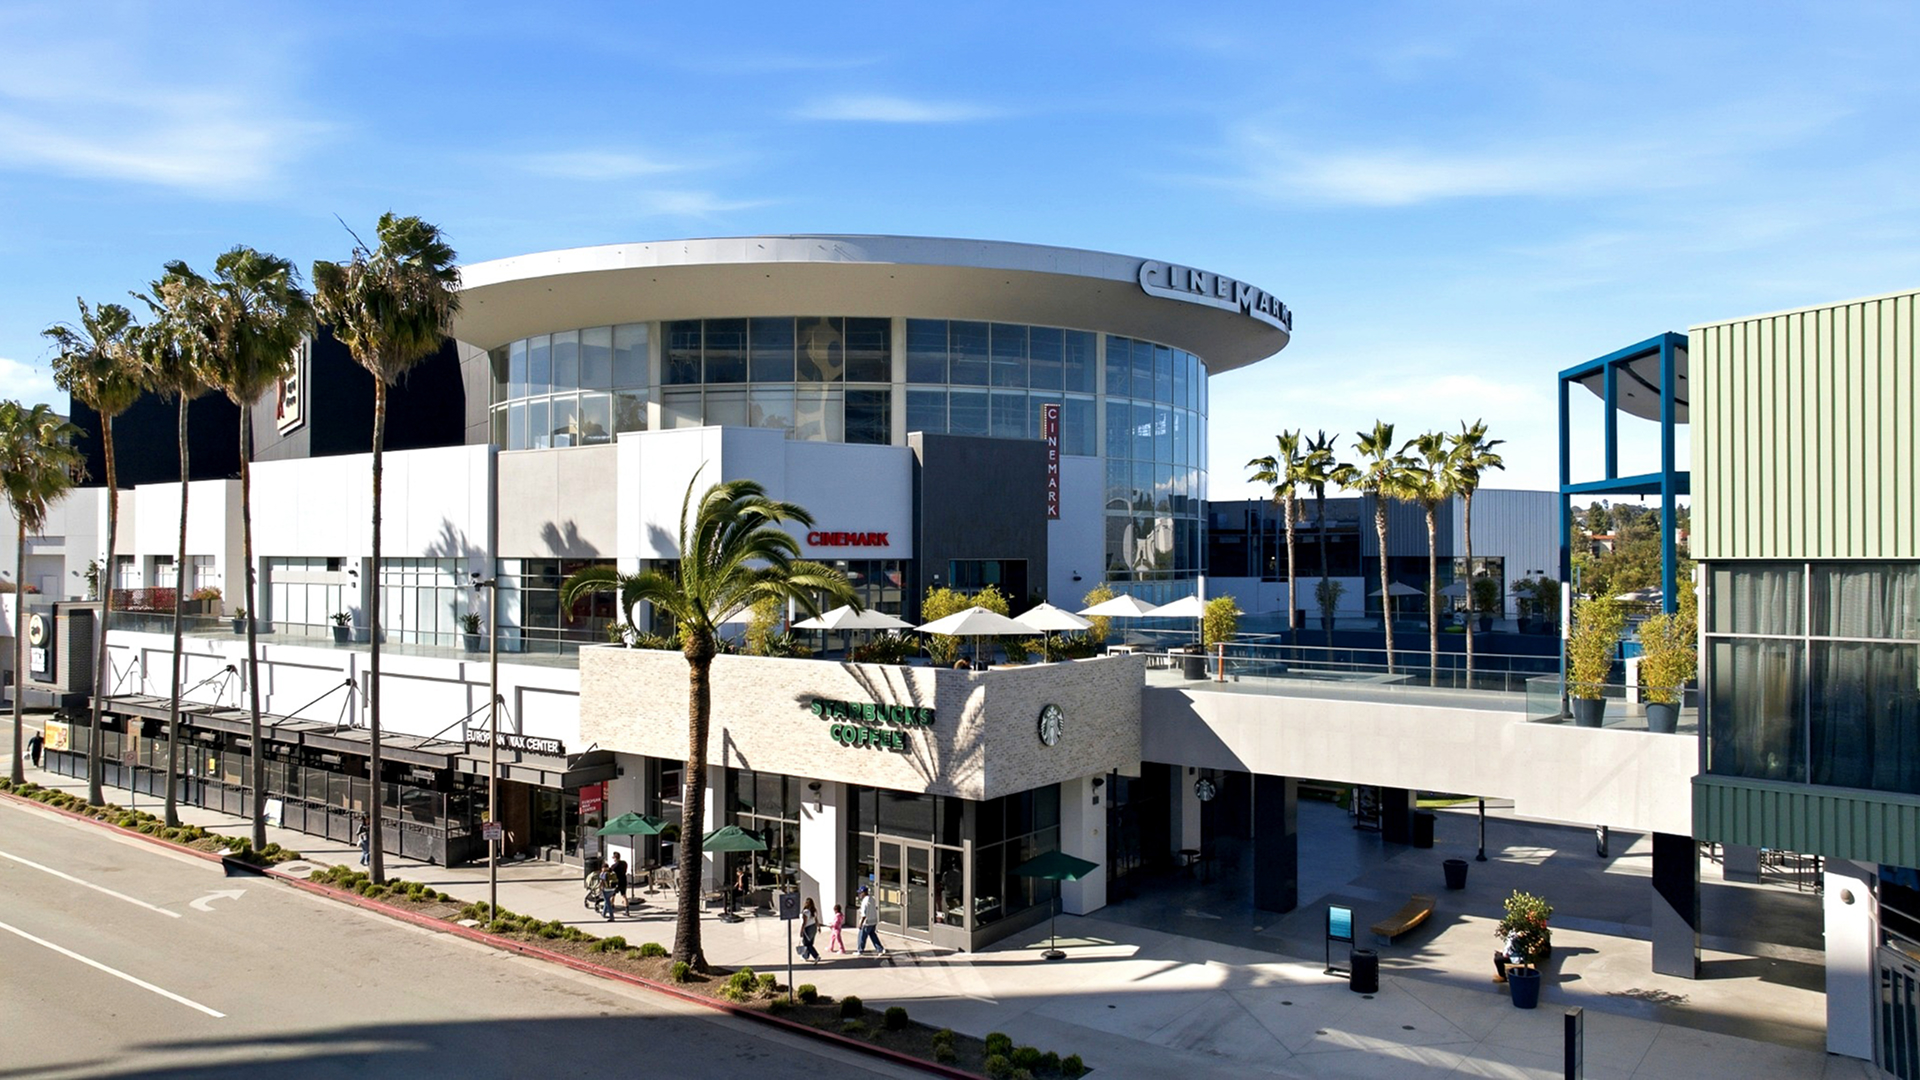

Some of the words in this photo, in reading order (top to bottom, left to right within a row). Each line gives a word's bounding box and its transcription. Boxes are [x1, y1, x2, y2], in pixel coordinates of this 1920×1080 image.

[1139, 260, 1292, 332] CINEMARK
[1048, 408, 1058, 516] CINEMARK
[807, 531, 889, 547] CINEMARK
[810, 700, 936, 726] STARBUCKS
[466, 729, 505, 746] EUROPN
[507, 735, 526, 749] WAX
[526, 738, 559, 753] CENTER
[830, 723, 905, 750] COFFEE
